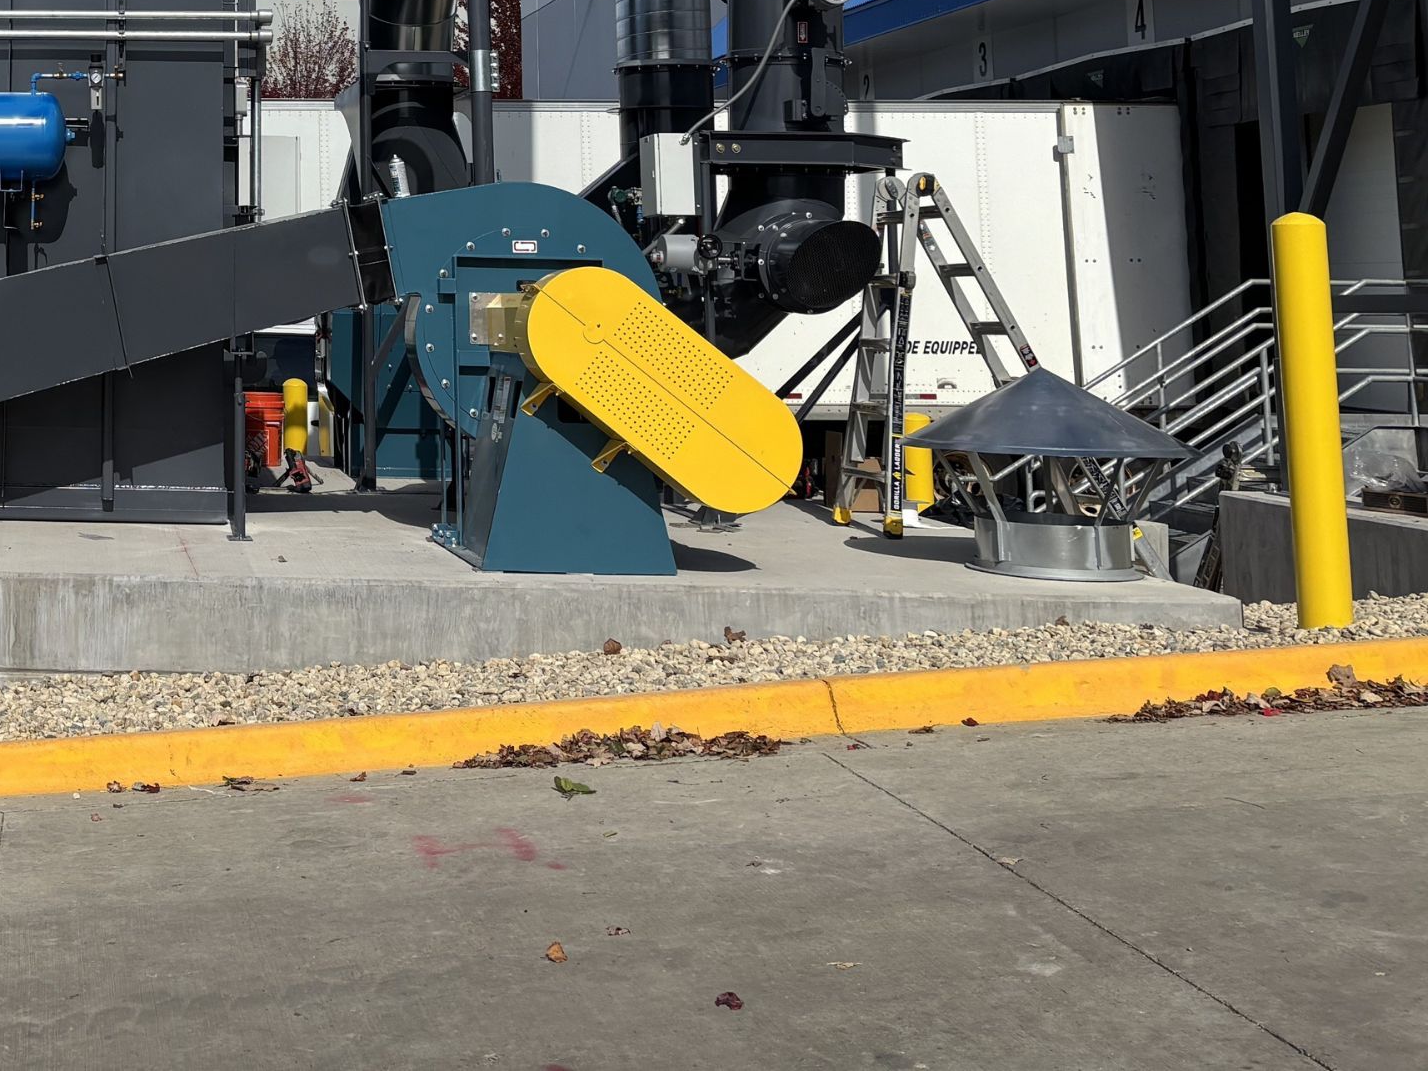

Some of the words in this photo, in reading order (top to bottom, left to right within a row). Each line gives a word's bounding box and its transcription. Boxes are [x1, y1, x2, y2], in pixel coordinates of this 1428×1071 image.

[978, 42, 987, 77] 3
[864, 74, 870, 100] 2
[924, 341, 982, 355] EQUIPPE
